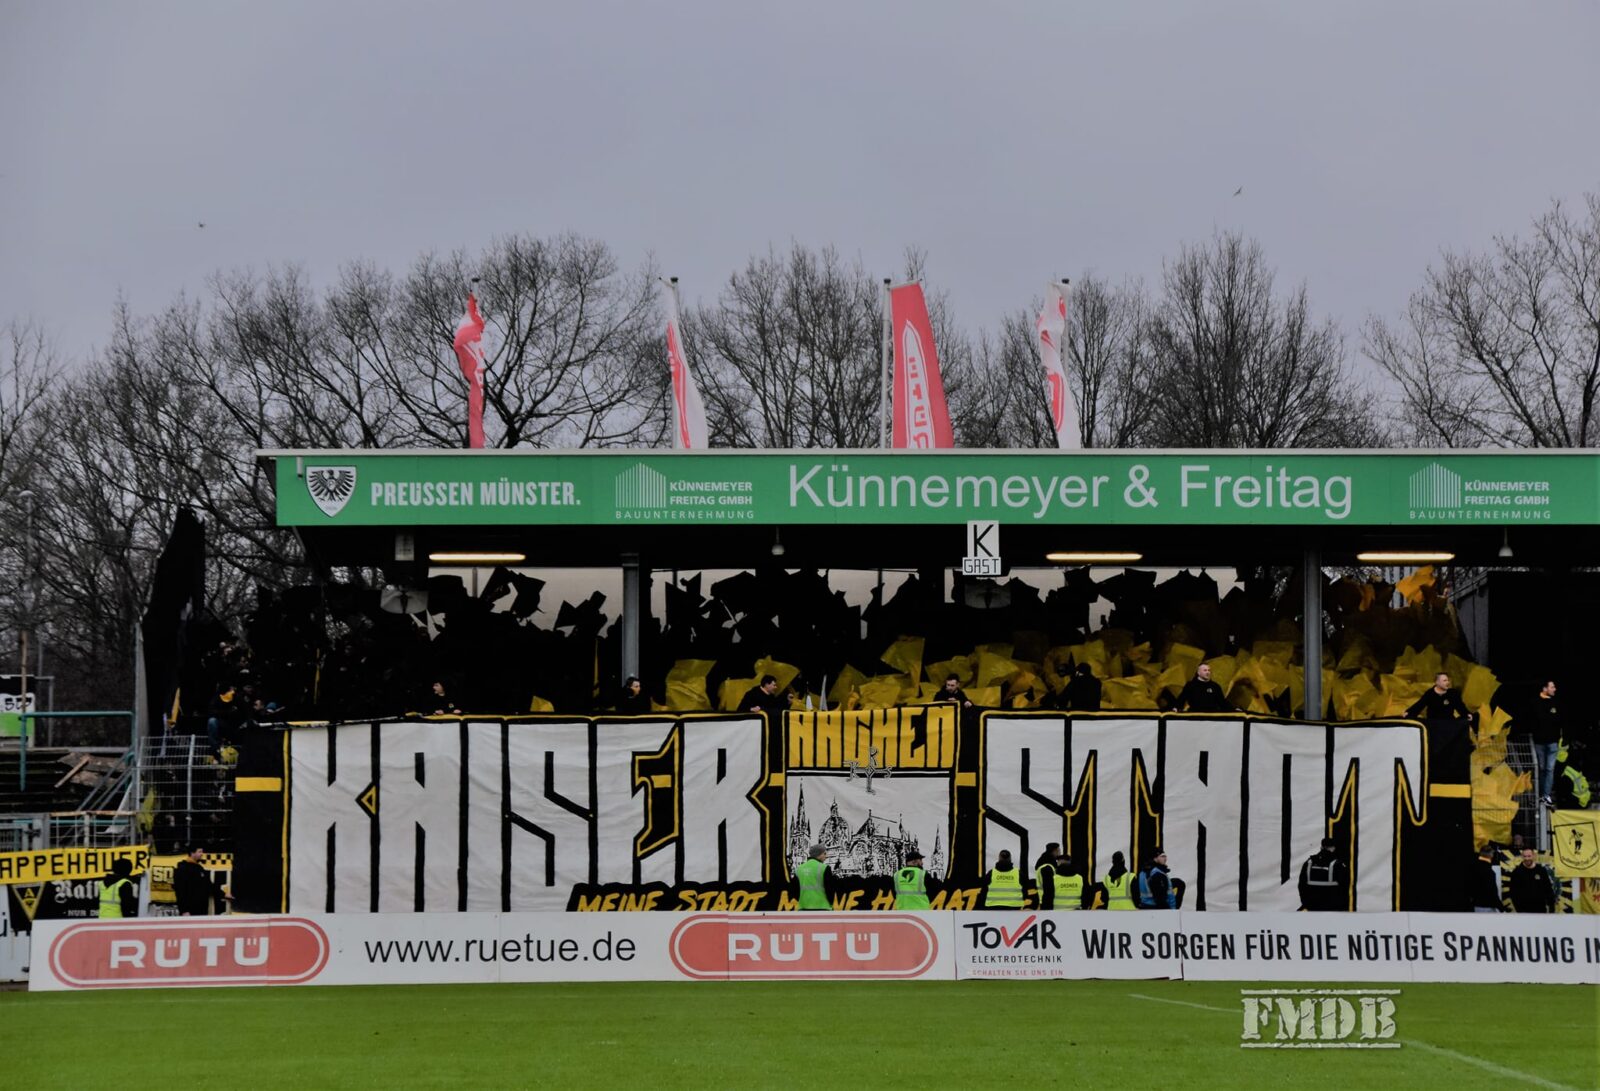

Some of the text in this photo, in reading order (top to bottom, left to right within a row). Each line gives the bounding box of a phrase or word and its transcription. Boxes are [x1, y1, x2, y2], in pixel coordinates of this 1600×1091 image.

[370, 477, 581, 506] PREUSSEN MÜNSTER.
[669, 480, 753, 492] KÜNNEMEYER
[669, 495, 753, 505] FREITAG GMBH
[789, 464, 1352, 520] Künnemeyer & Freitag
[1464, 480, 1550, 492] KÜNNEMEYER
[1464, 495, 1550, 505] FREITAG GMBH
[615, 510, 754, 519] BAUUNTERNEHMUNG
[1409, 510, 1551, 519] BAUUNTERNEHMUNG
[973, 524, 994, 557] K
[963, 559, 1000, 574] GAST
[789, 704, 956, 768] AACHEN
[290, 719, 767, 912] KAISER
[577, 890, 664, 911] MEINE
[674, 889, 767, 911] STADT
[962, 914, 1062, 949] TOVAR
[109, 937, 269, 969] RÜTÜ
[365, 930, 636, 963] www.ruetue.de
[728, 932, 880, 961] RÜTÜ
[971, 955, 1063, 964] ELEKTROTECHNIK
[1081, 929, 1133, 959] WIR
[1141, 932, 1235, 960] SORGEN
[1245, 929, 1292, 961] FÜR
[1299, 934, 1339, 961] DIE
[1348, 929, 1435, 961] NÖTIGE
[1443, 931, 1575, 964] SPANNUNG
